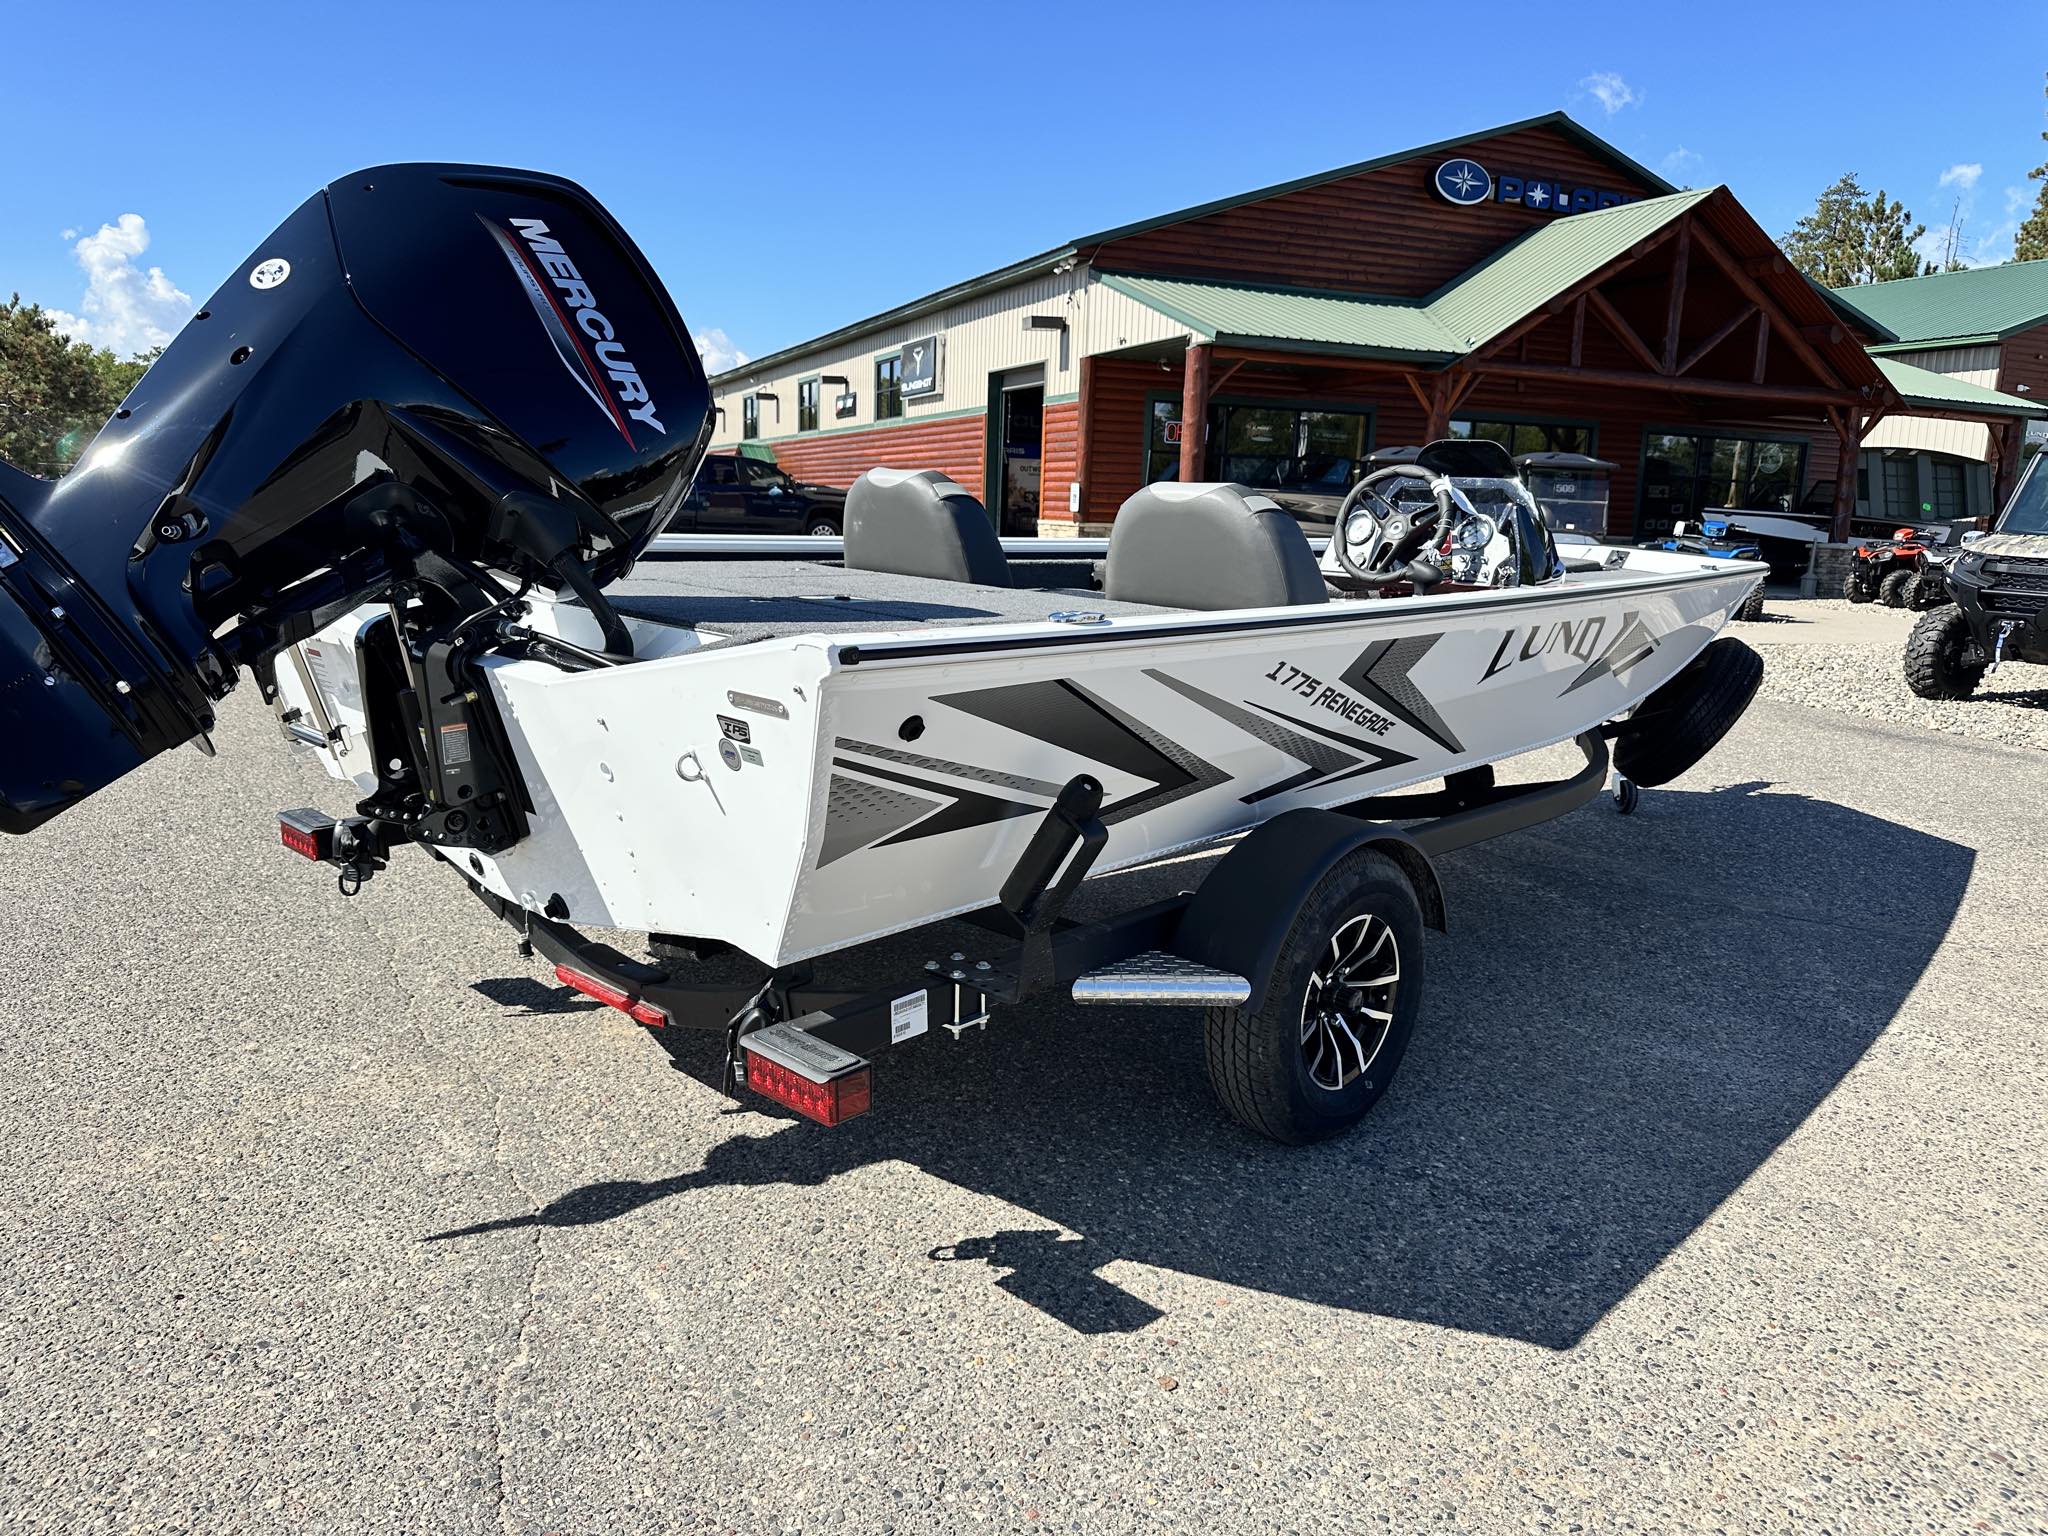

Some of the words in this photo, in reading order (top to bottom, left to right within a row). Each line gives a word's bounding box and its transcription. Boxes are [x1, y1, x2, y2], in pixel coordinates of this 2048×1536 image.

[1497, 175, 1643, 214] POLAR
[509, 218, 667, 435] MERCURY
[1166, 423, 1184, 441] OP
[1555, 484, 1576, 494] 509
[2009, 565, 2048, 575] POLARI
[1477, 616, 1607, 685] LUND
[1265, 660, 1323, 698] 1775
[1310, 686, 1397, 737] RENEGADE
[724, 722, 748, 737] IPS
